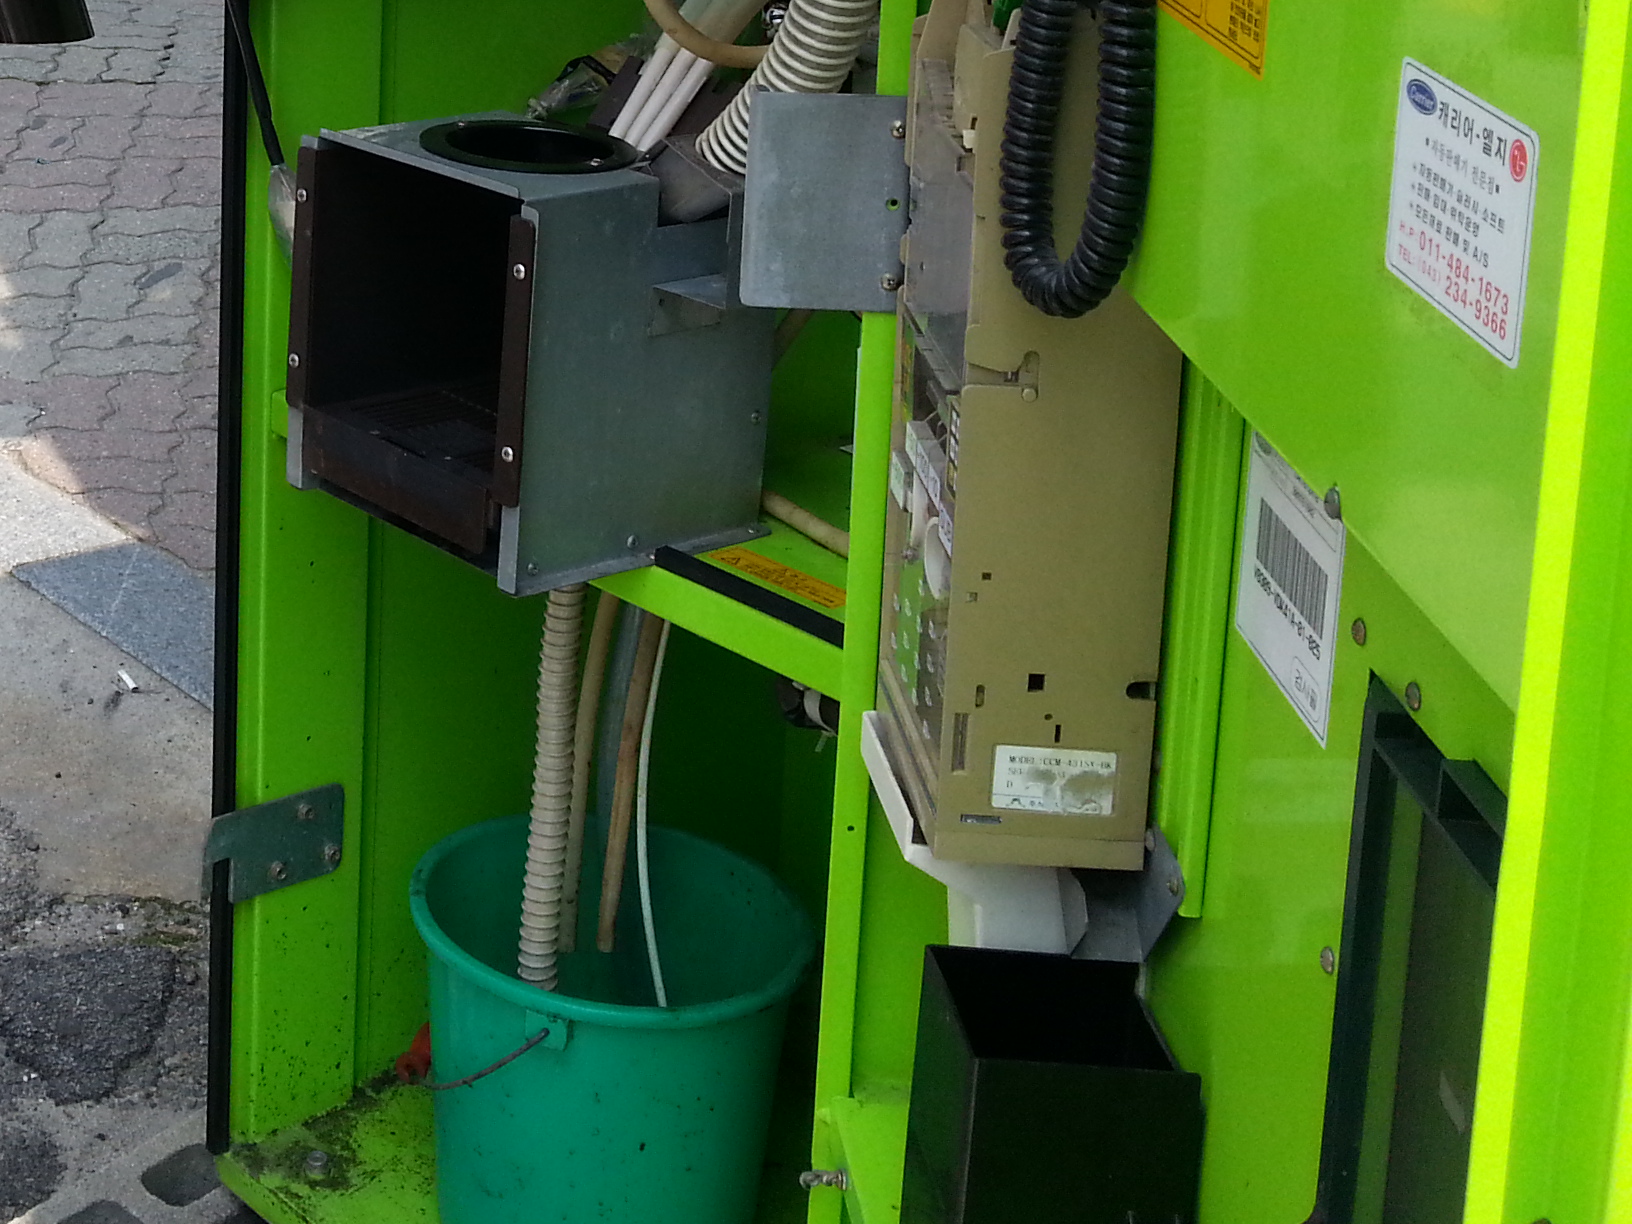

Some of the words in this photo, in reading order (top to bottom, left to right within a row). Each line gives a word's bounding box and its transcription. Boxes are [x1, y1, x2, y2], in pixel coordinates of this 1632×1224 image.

[1409, 84, 1435, 111] Carrier
[1431, 138, 1469, 178] 자동판매기
[1419, 230, 1510, 316] 011-484-1673
[1472, 245, 1489, 269] A/S
[1444, 275, 1507, 341] 234-9366
